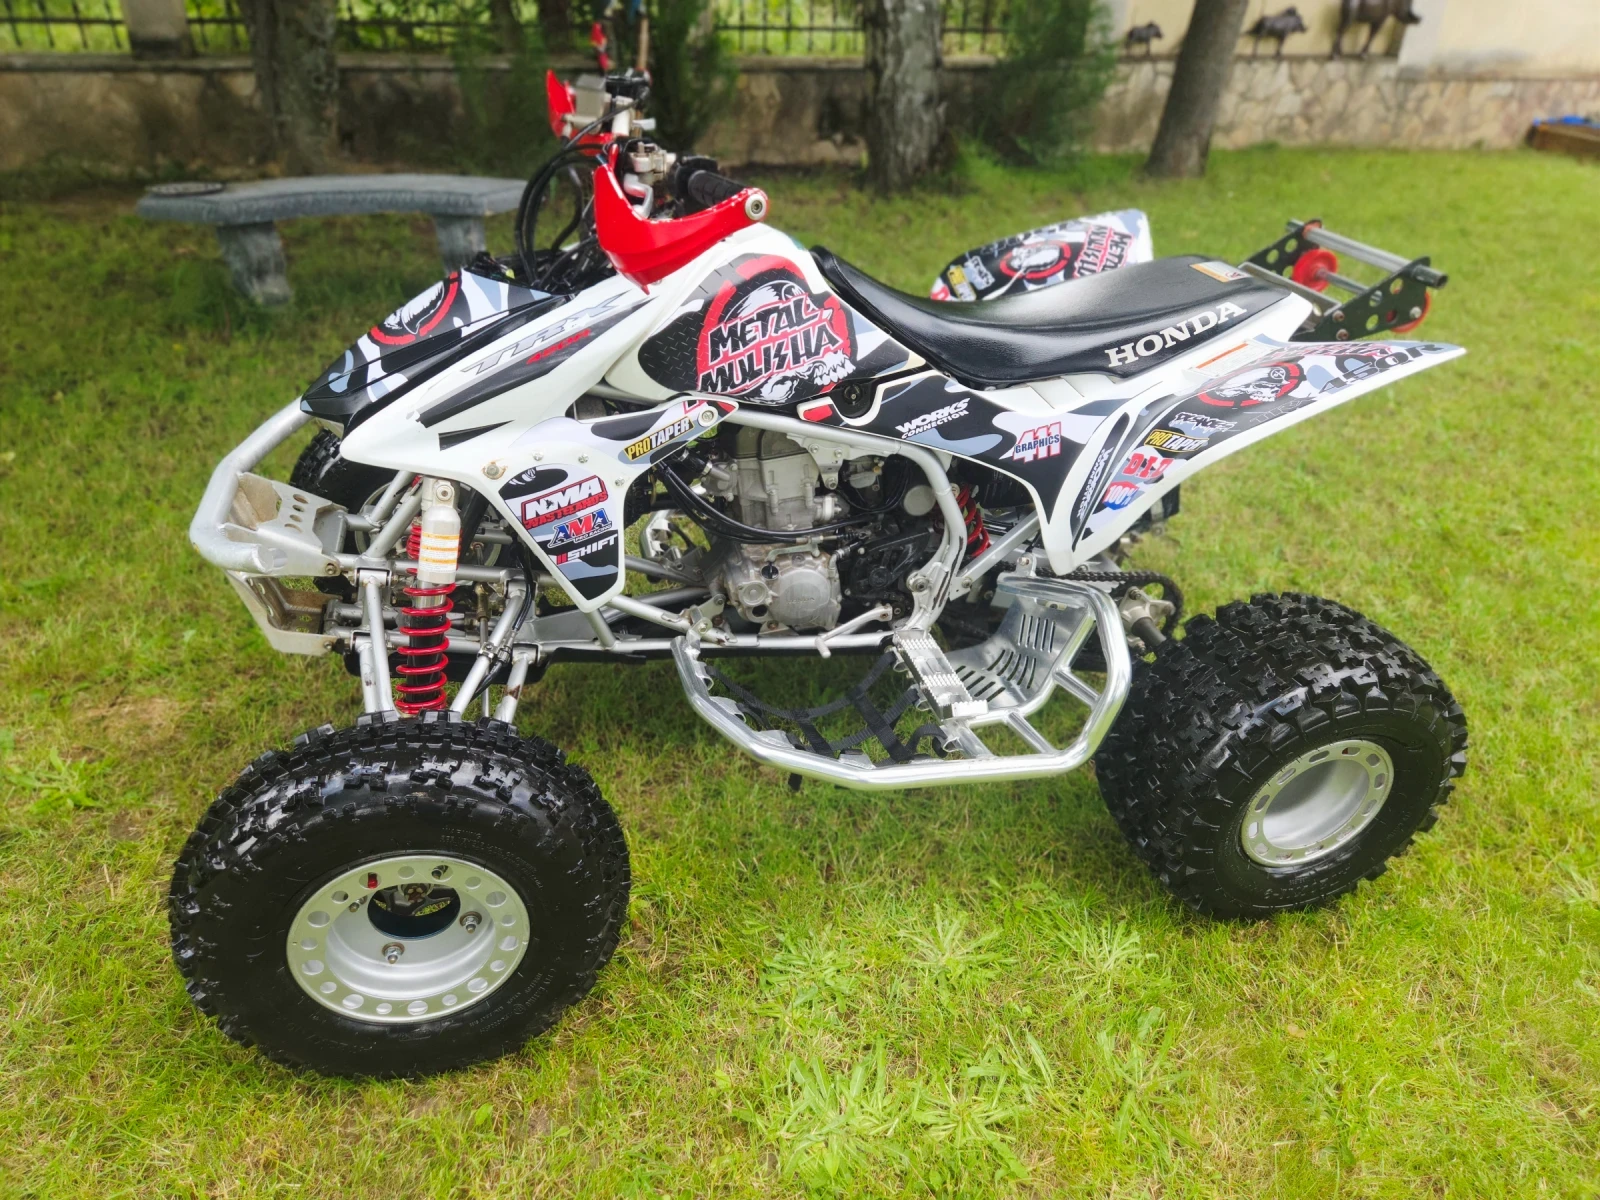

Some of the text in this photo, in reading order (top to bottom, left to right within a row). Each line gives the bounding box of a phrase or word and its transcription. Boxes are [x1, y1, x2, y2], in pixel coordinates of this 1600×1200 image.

[1099, 230, 1133, 271] META
[460, 289, 632, 375] TRX
[708, 293, 822, 365] METAL
[1104, 301, 1247, 367] HONDA
[698, 322, 844, 394] MULISHA
[1318, 343, 1445, 394] 450R
[895, 397, 970, 433] WORKS
[901, 410, 969, 440] CONNECTION
[626, 417, 691, 460] PROTAPER
[1013, 421, 1062, 464] 411
[1015, 433, 1060, 453] GRAPHICS
[525, 477, 603, 520] NMA
[547, 508, 612, 548] AMA
[567, 533, 618, 561] SHIFT
